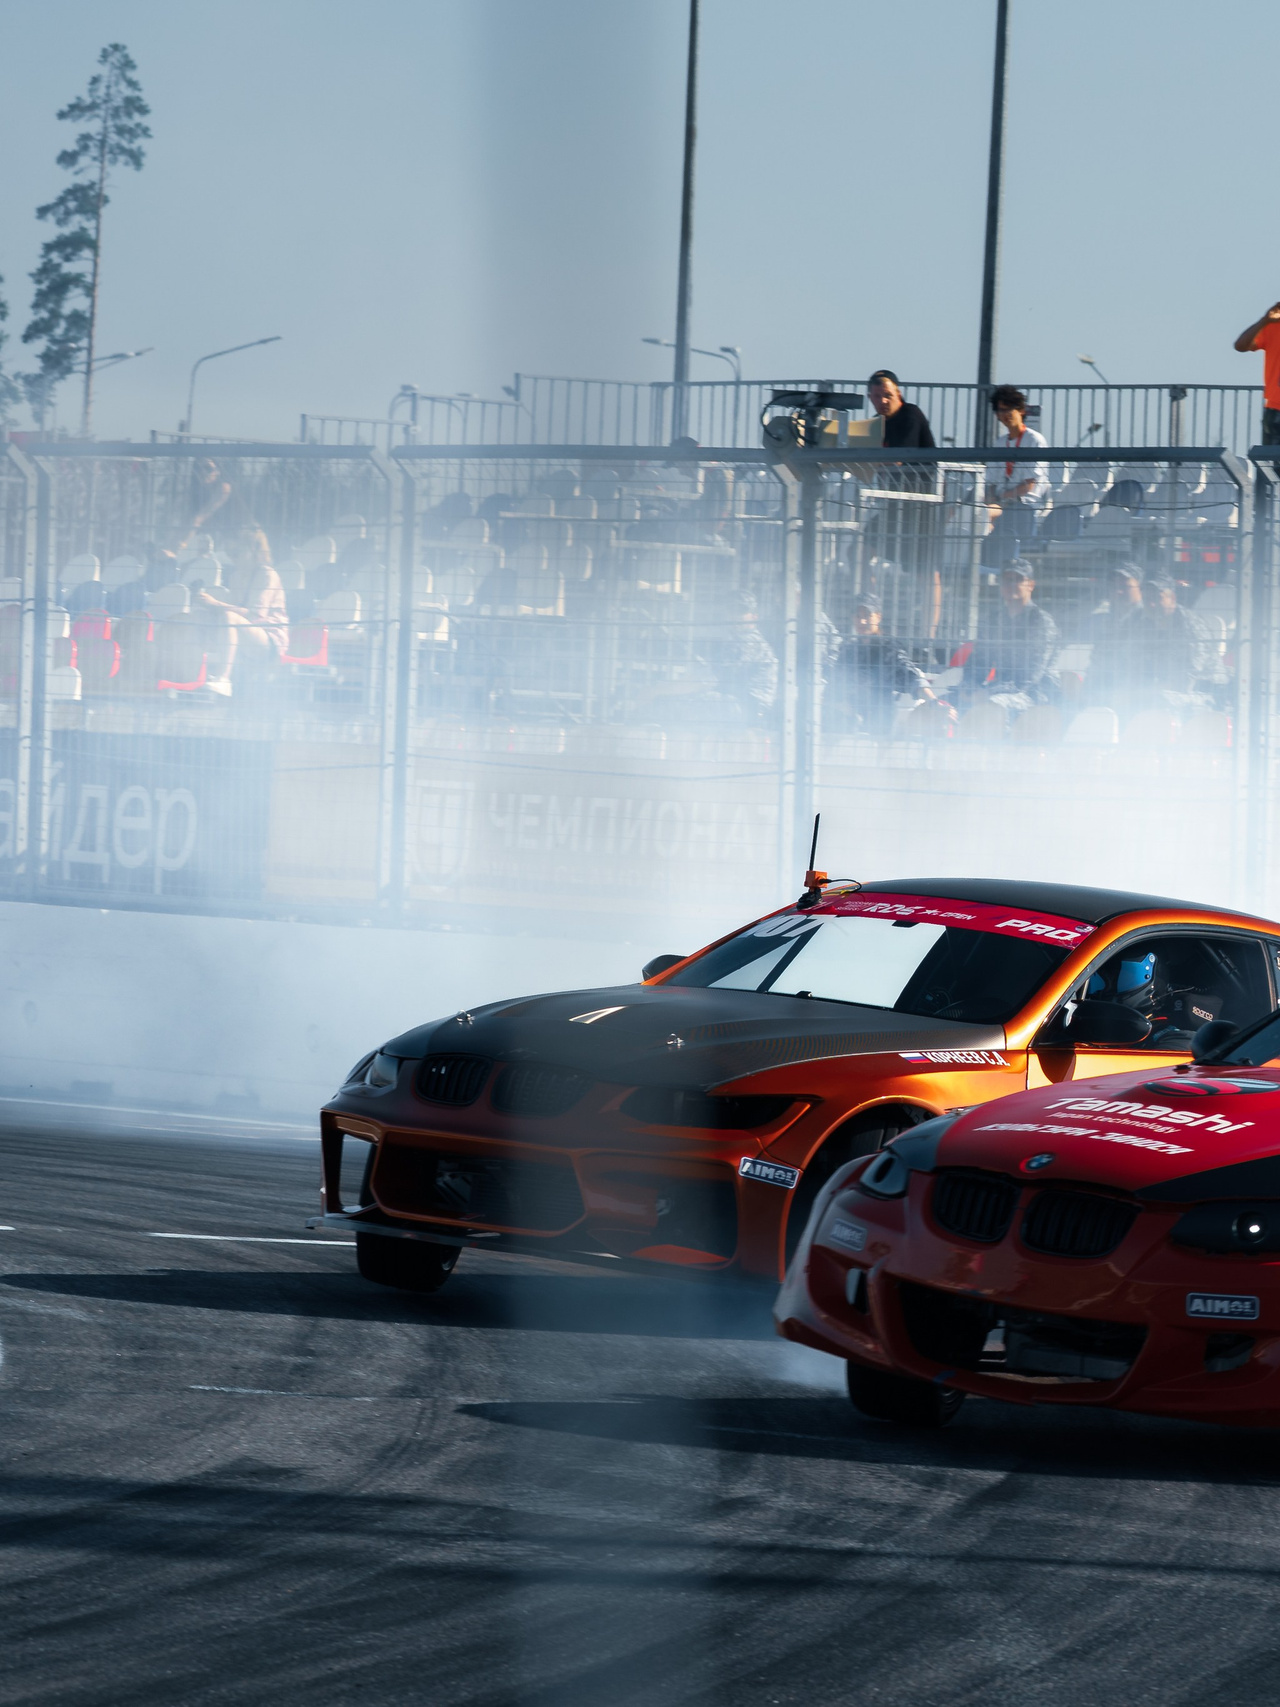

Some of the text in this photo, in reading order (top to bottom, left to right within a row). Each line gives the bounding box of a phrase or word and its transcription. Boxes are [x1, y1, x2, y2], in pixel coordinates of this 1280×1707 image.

[488, 792, 779, 861] ЧЕМПИОНАТ
[994, 919, 1081, 941] PRO
[922, 1051, 986, 1064] КОРНЕЕВ
[1044, 1098, 1255, 1134] Tamashi
[1190, 1298, 1255, 1315] AIMOL
